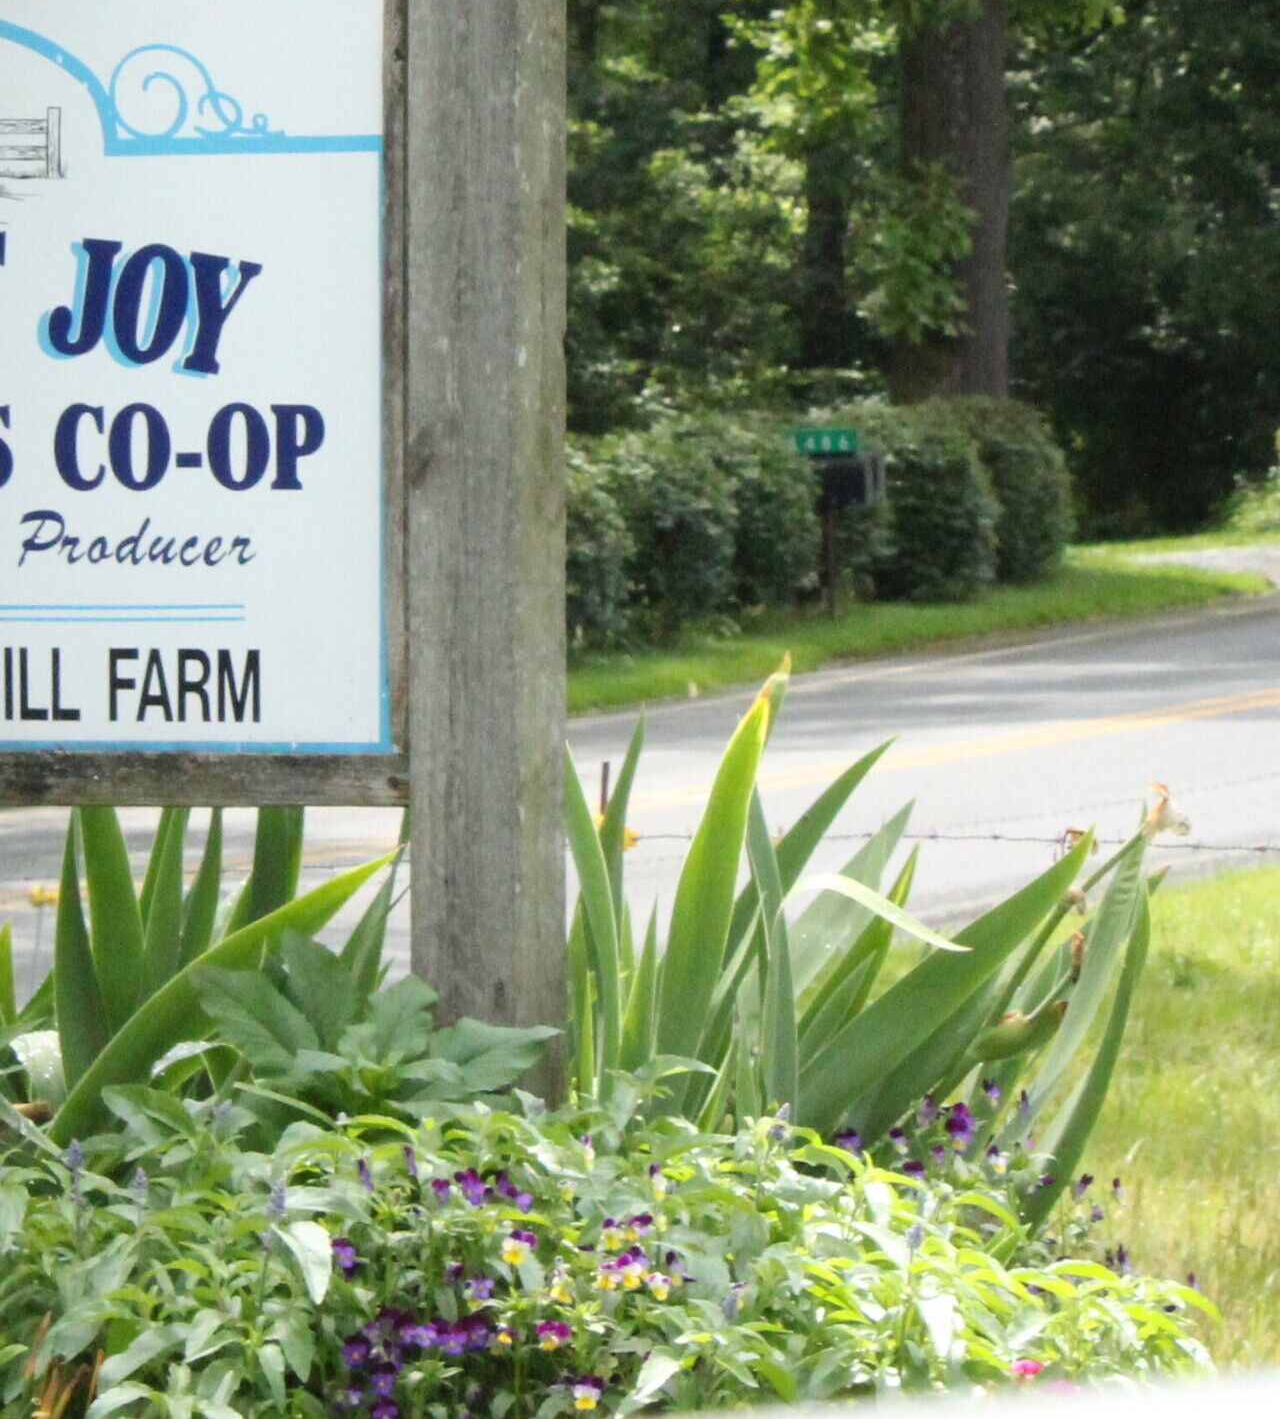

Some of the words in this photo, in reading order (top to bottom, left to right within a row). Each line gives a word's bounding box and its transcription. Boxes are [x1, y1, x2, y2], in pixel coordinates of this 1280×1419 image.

[38, 238, 263, 378] JOY
[54, 402, 326, 492] CO-OP
[18, 509, 257, 568] Producer
[108, 647, 261, 723] FARM
